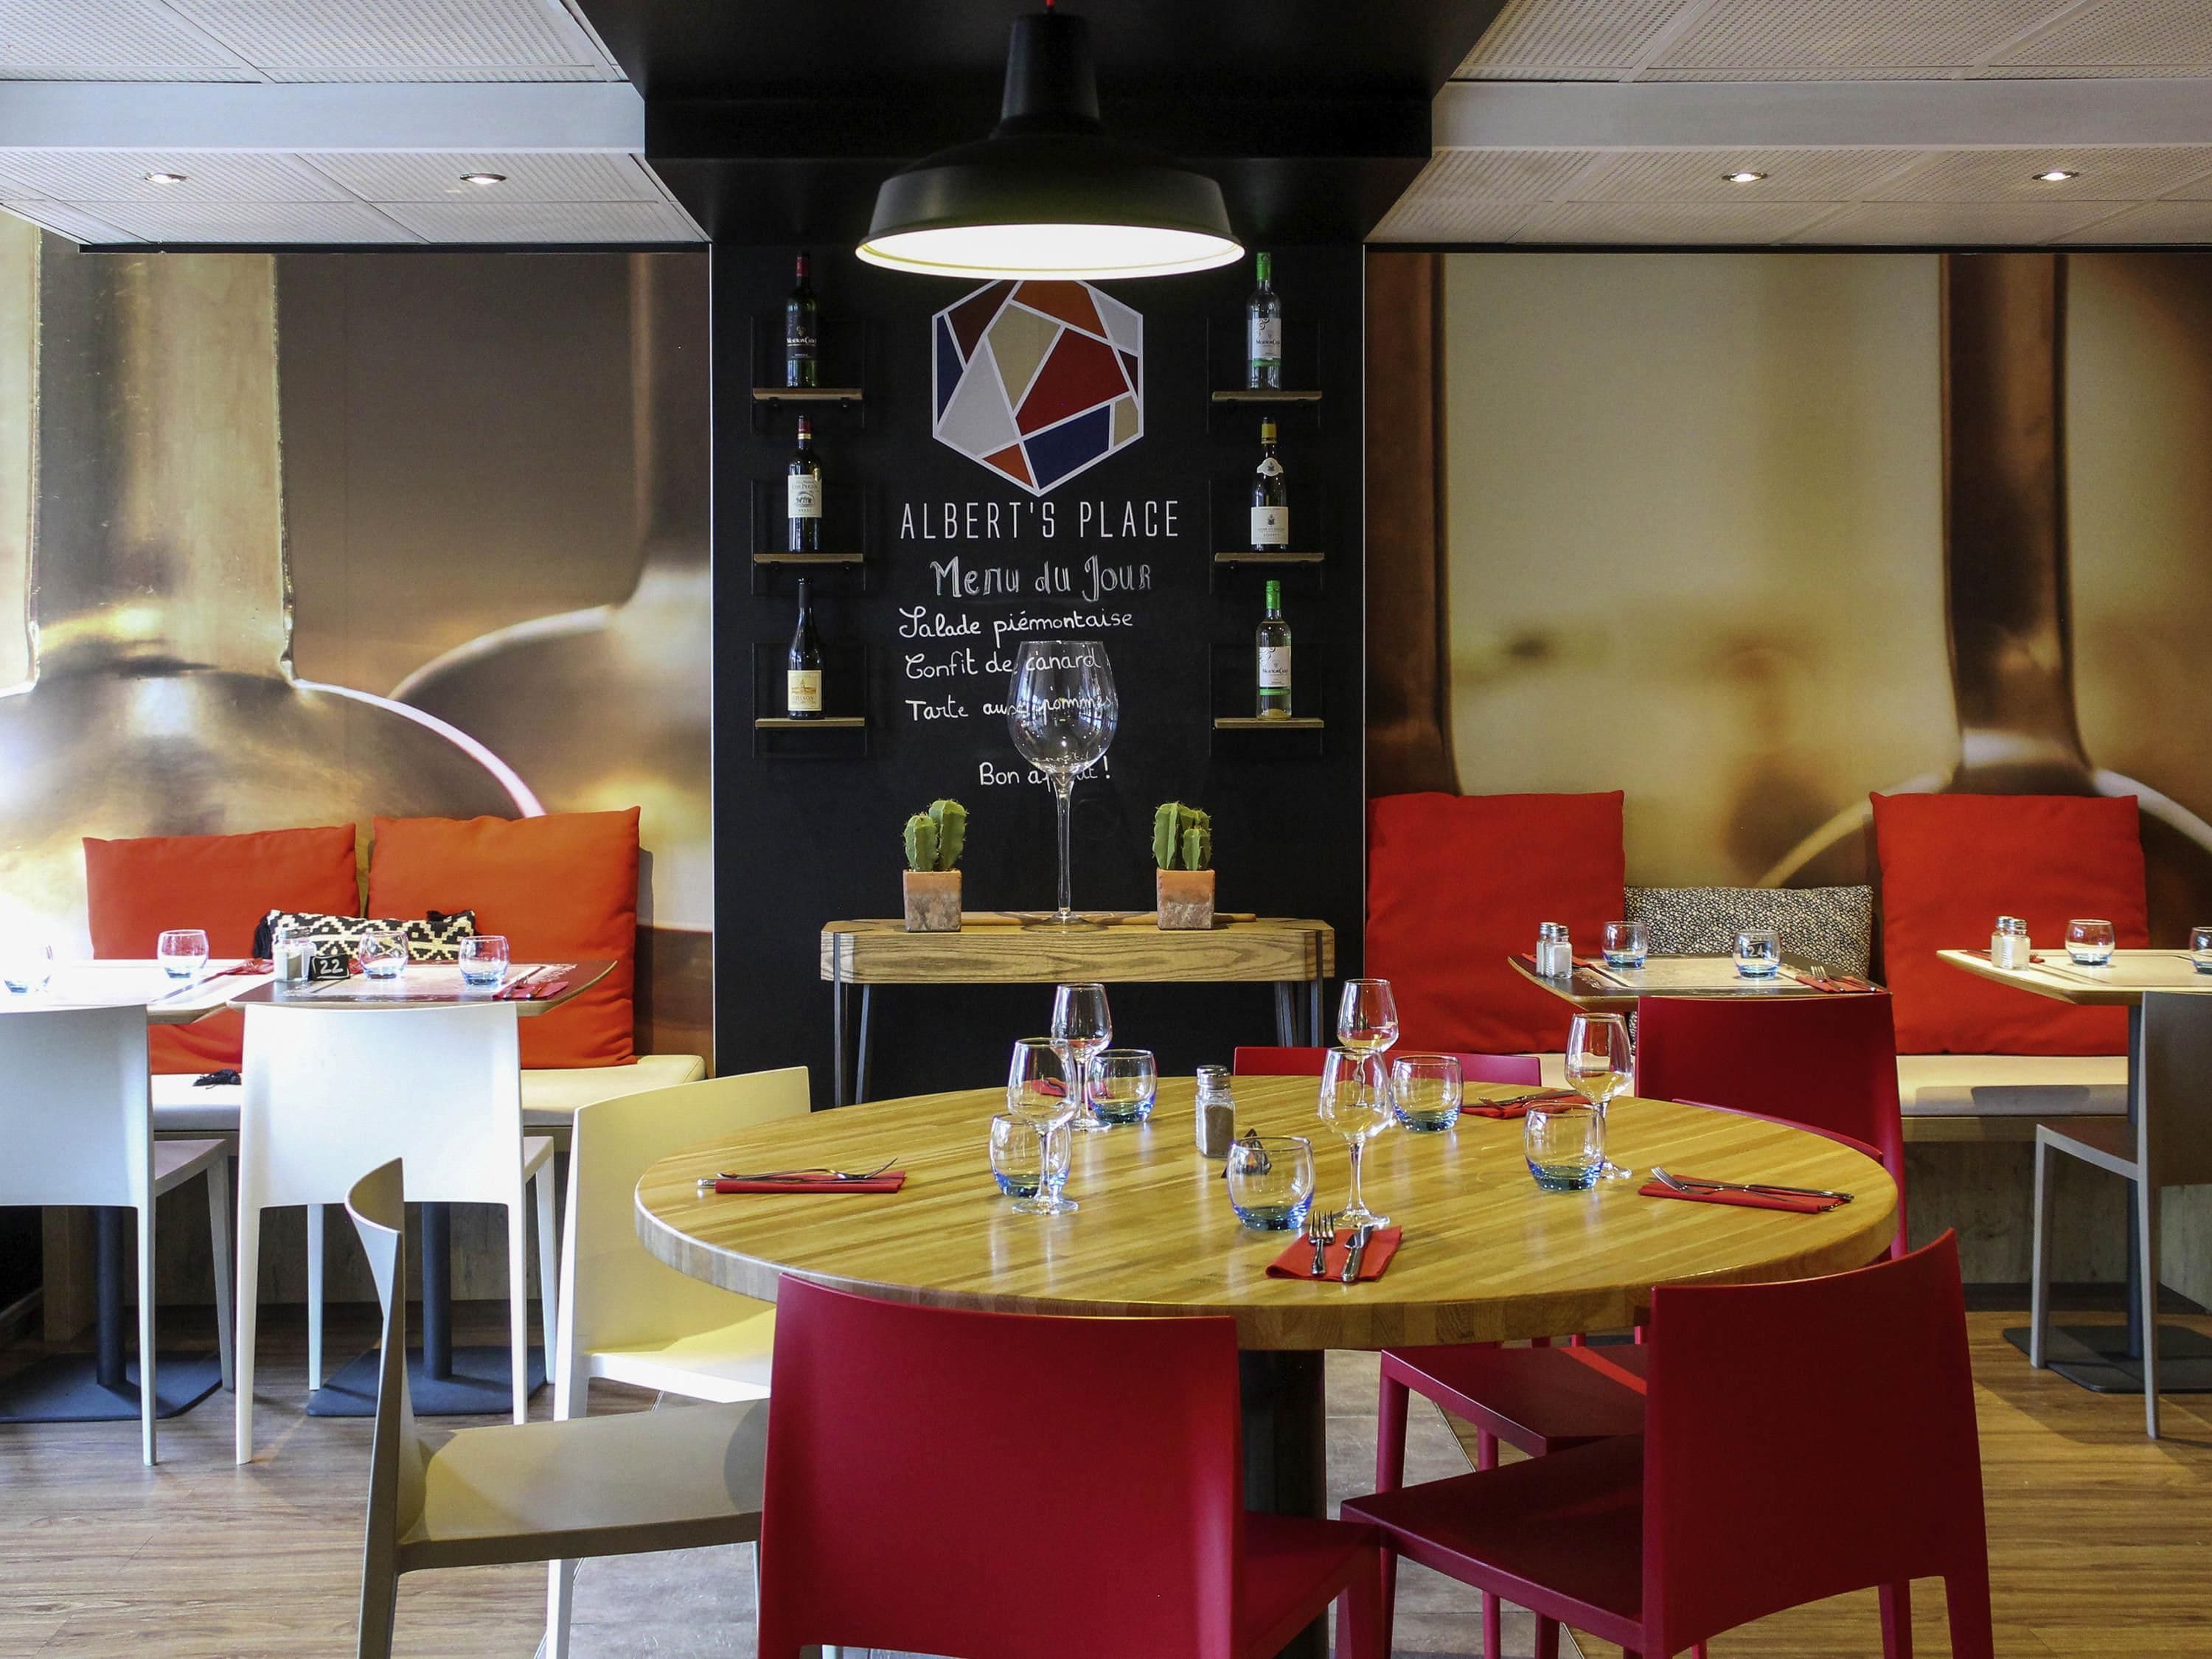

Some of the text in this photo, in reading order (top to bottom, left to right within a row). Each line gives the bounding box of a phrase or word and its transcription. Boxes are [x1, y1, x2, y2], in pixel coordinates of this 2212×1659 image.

[900, 501, 1178, 540] ALBERT'S PLACE
[929, 555, 1020, 598] Menu
[1034, 560, 1071, 594] du
[898, 605, 1133, 648] Salade piémontaise
[905, 647, 1102, 679] Confit de canard
[905, 694, 969, 721] Tarte
[979, 762, 1020, 785] Bon
[1747, 945, 1764, 957] 24
[320, 959, 344, 975] 22
